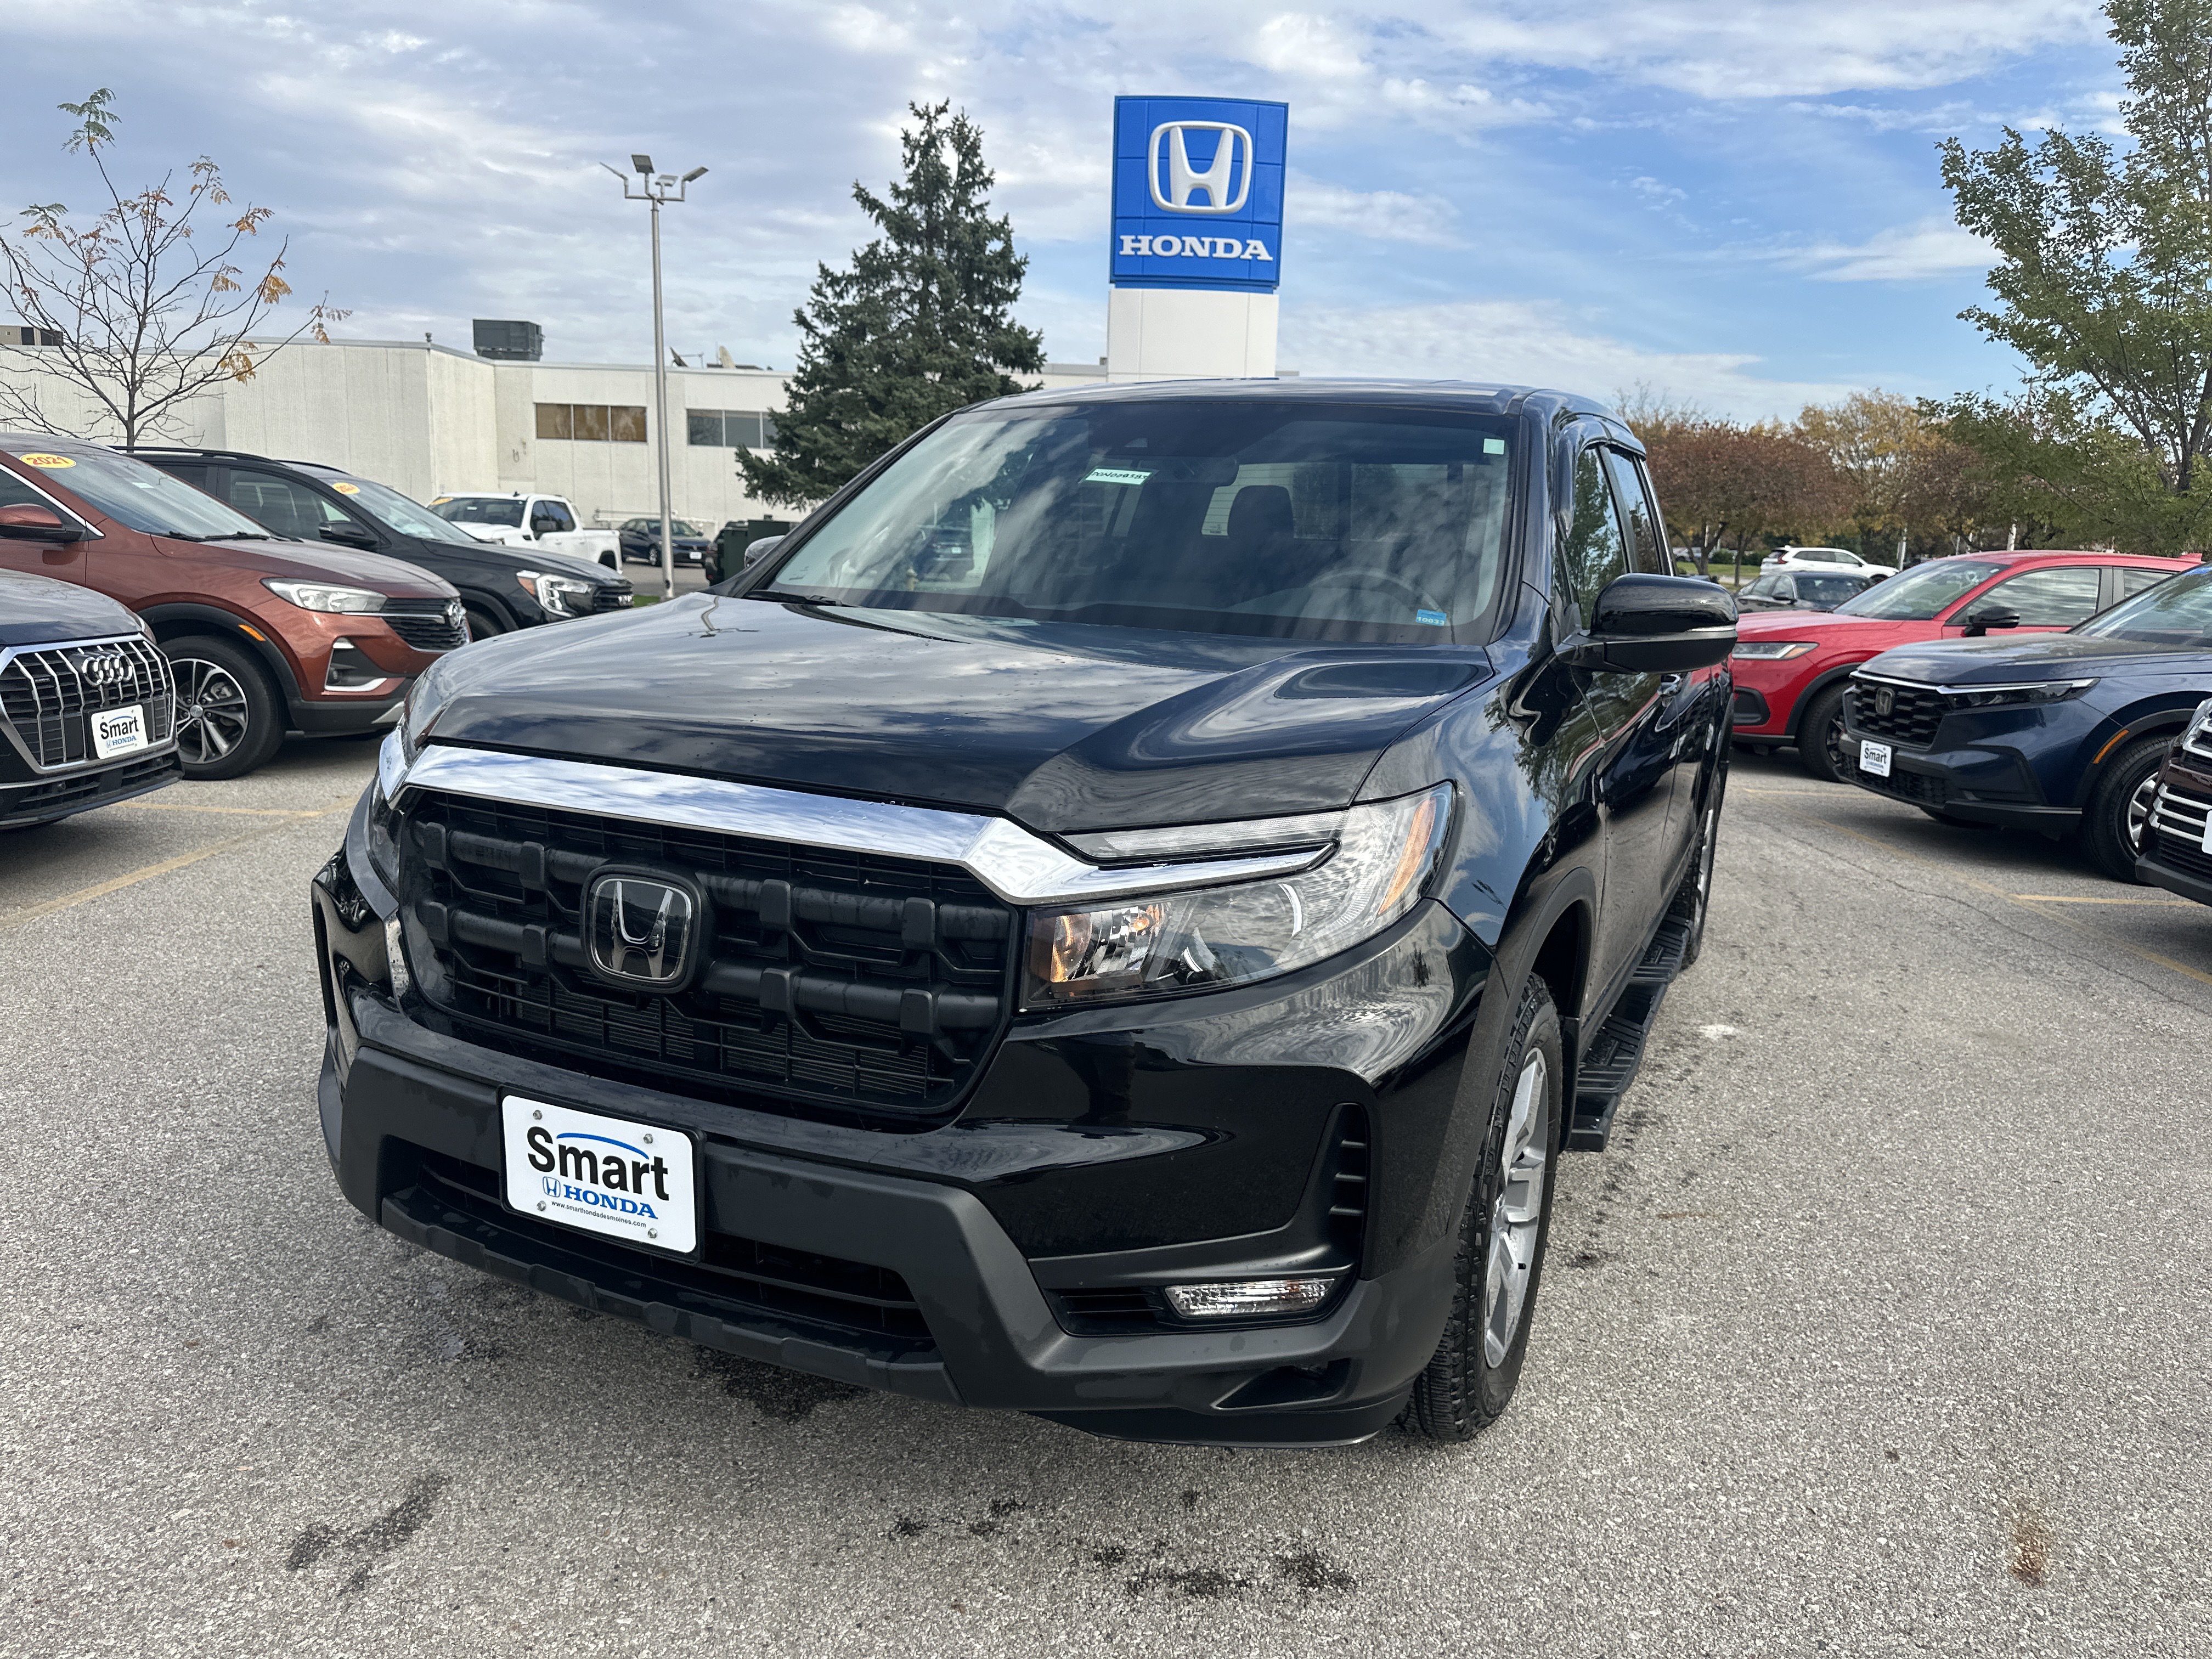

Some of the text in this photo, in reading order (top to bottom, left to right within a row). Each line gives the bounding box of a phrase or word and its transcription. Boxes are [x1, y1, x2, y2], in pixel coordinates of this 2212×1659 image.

[1119, 235, 1273, 261] HONDA
[26, 456, 69, 465] 2021
[100, 716, 139, 740] Smart
[112, 735, 137, 746] HONDA
[1864, 747, 1887, 764] Smart
[527, 1126, 669, 1201] Smart
[551, 1200, 646, 1227] www.smarthondadesmoines.com
[563, 1184, 658, 1219] HONDA
